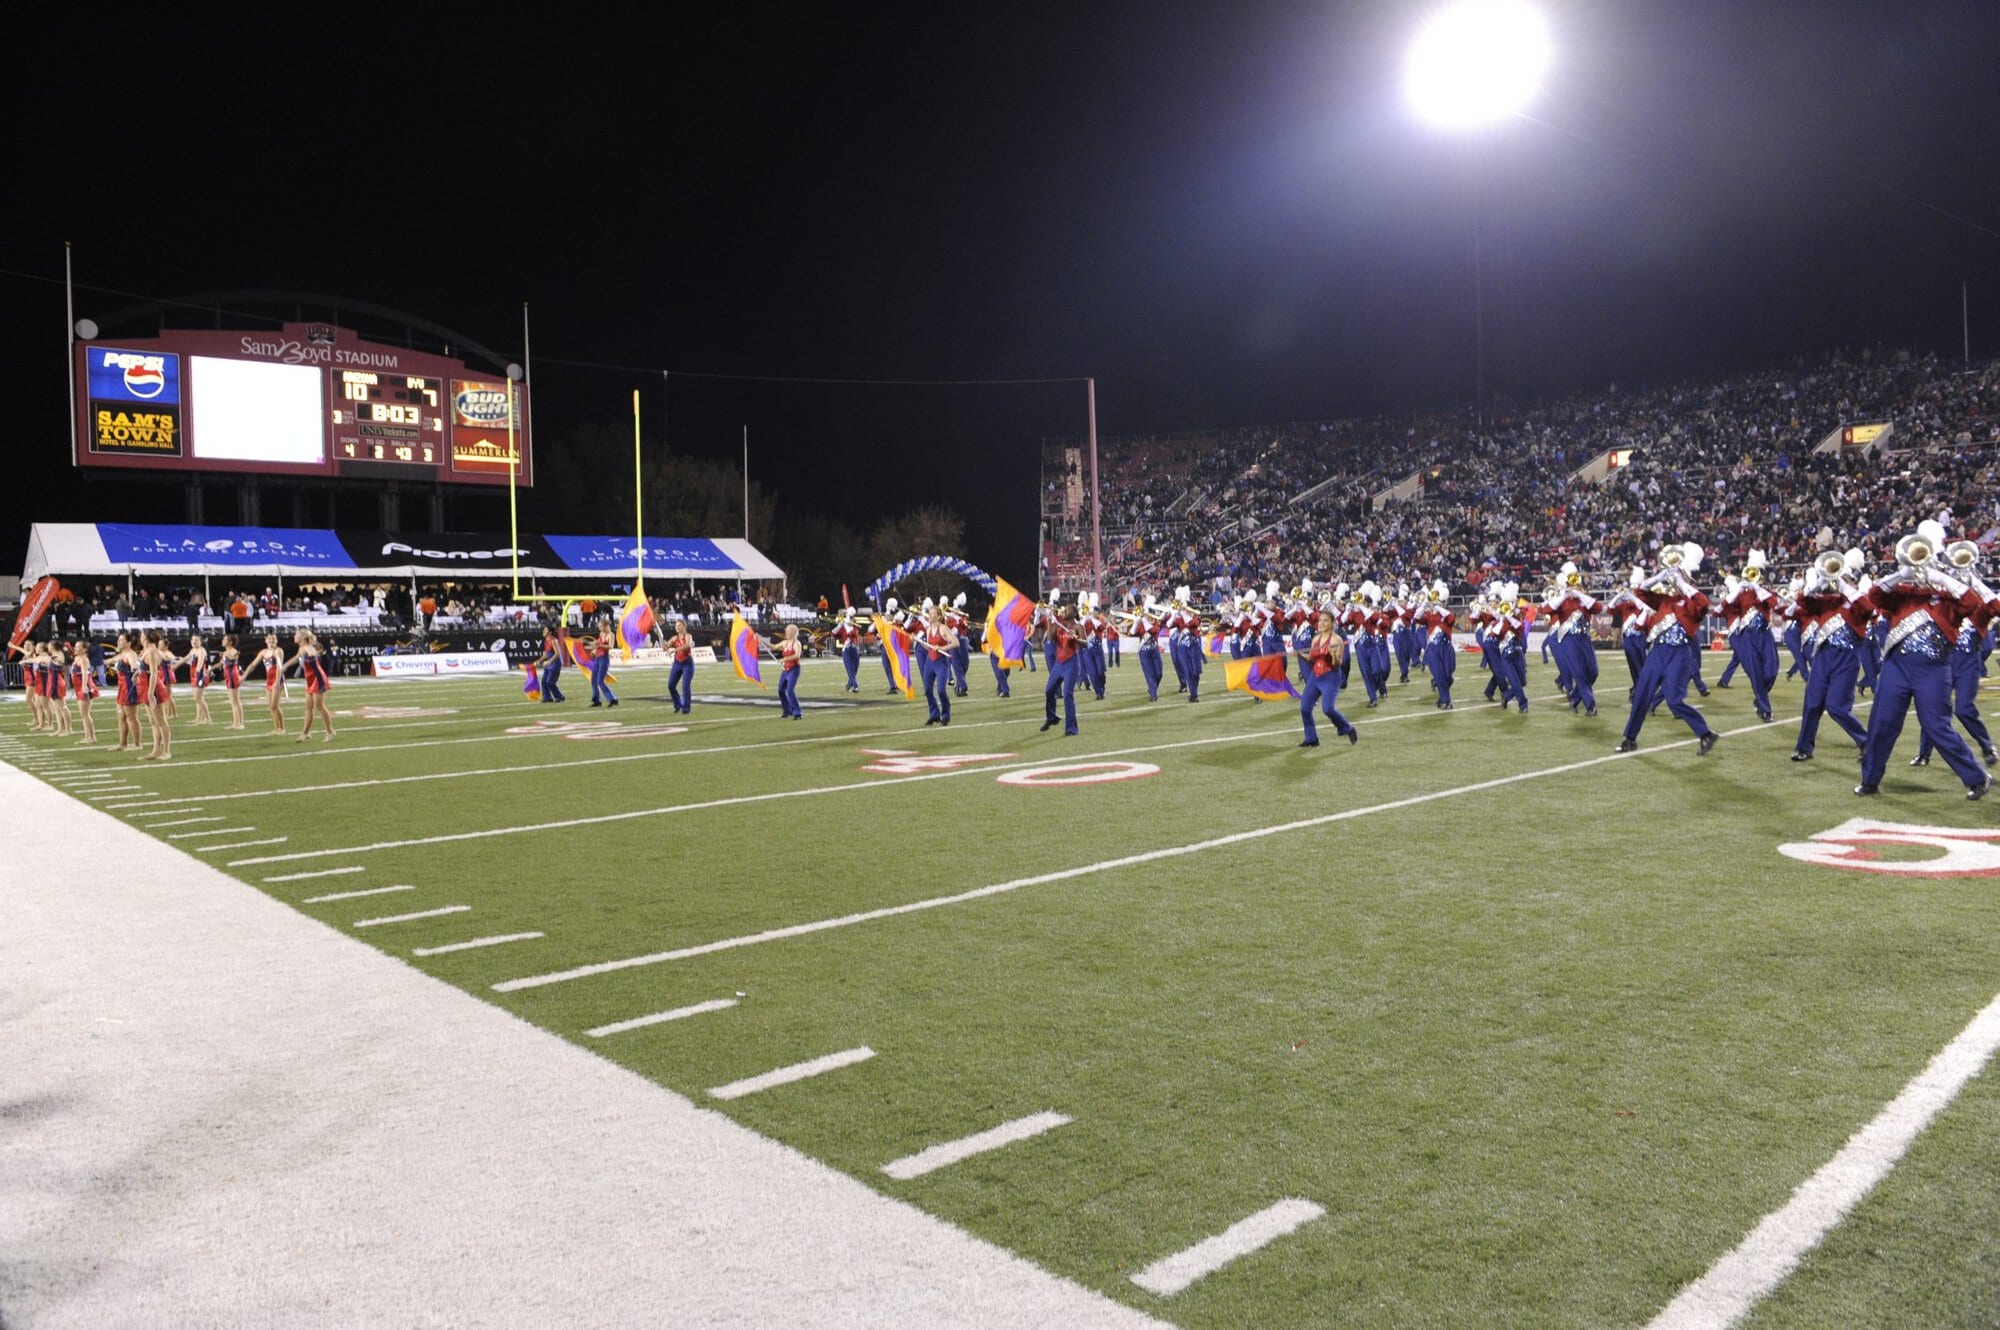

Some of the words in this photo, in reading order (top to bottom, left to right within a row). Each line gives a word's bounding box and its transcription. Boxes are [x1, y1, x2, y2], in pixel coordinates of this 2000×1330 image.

[240, 336, 277, 356] Sam
[276, 338, 332, 363] Boyd
[335, 349, 398, 368] STADIUM
[344, 382, 368, 401] 10
[422, 389, 437, 407] 7
[465, 392, 506, 403] BUD
[372, 404, 419, 424] 8:03
[460, 403, 509, 414] LIGHT
[98, 411, 174, 429] SAM'S
[98, 426, 174, 443] TOWN
[132, 546, 231, 554] FURNITURE
[382, 542, 531, 559] Pioneer
[461, 657, 502, 667] Chevron
